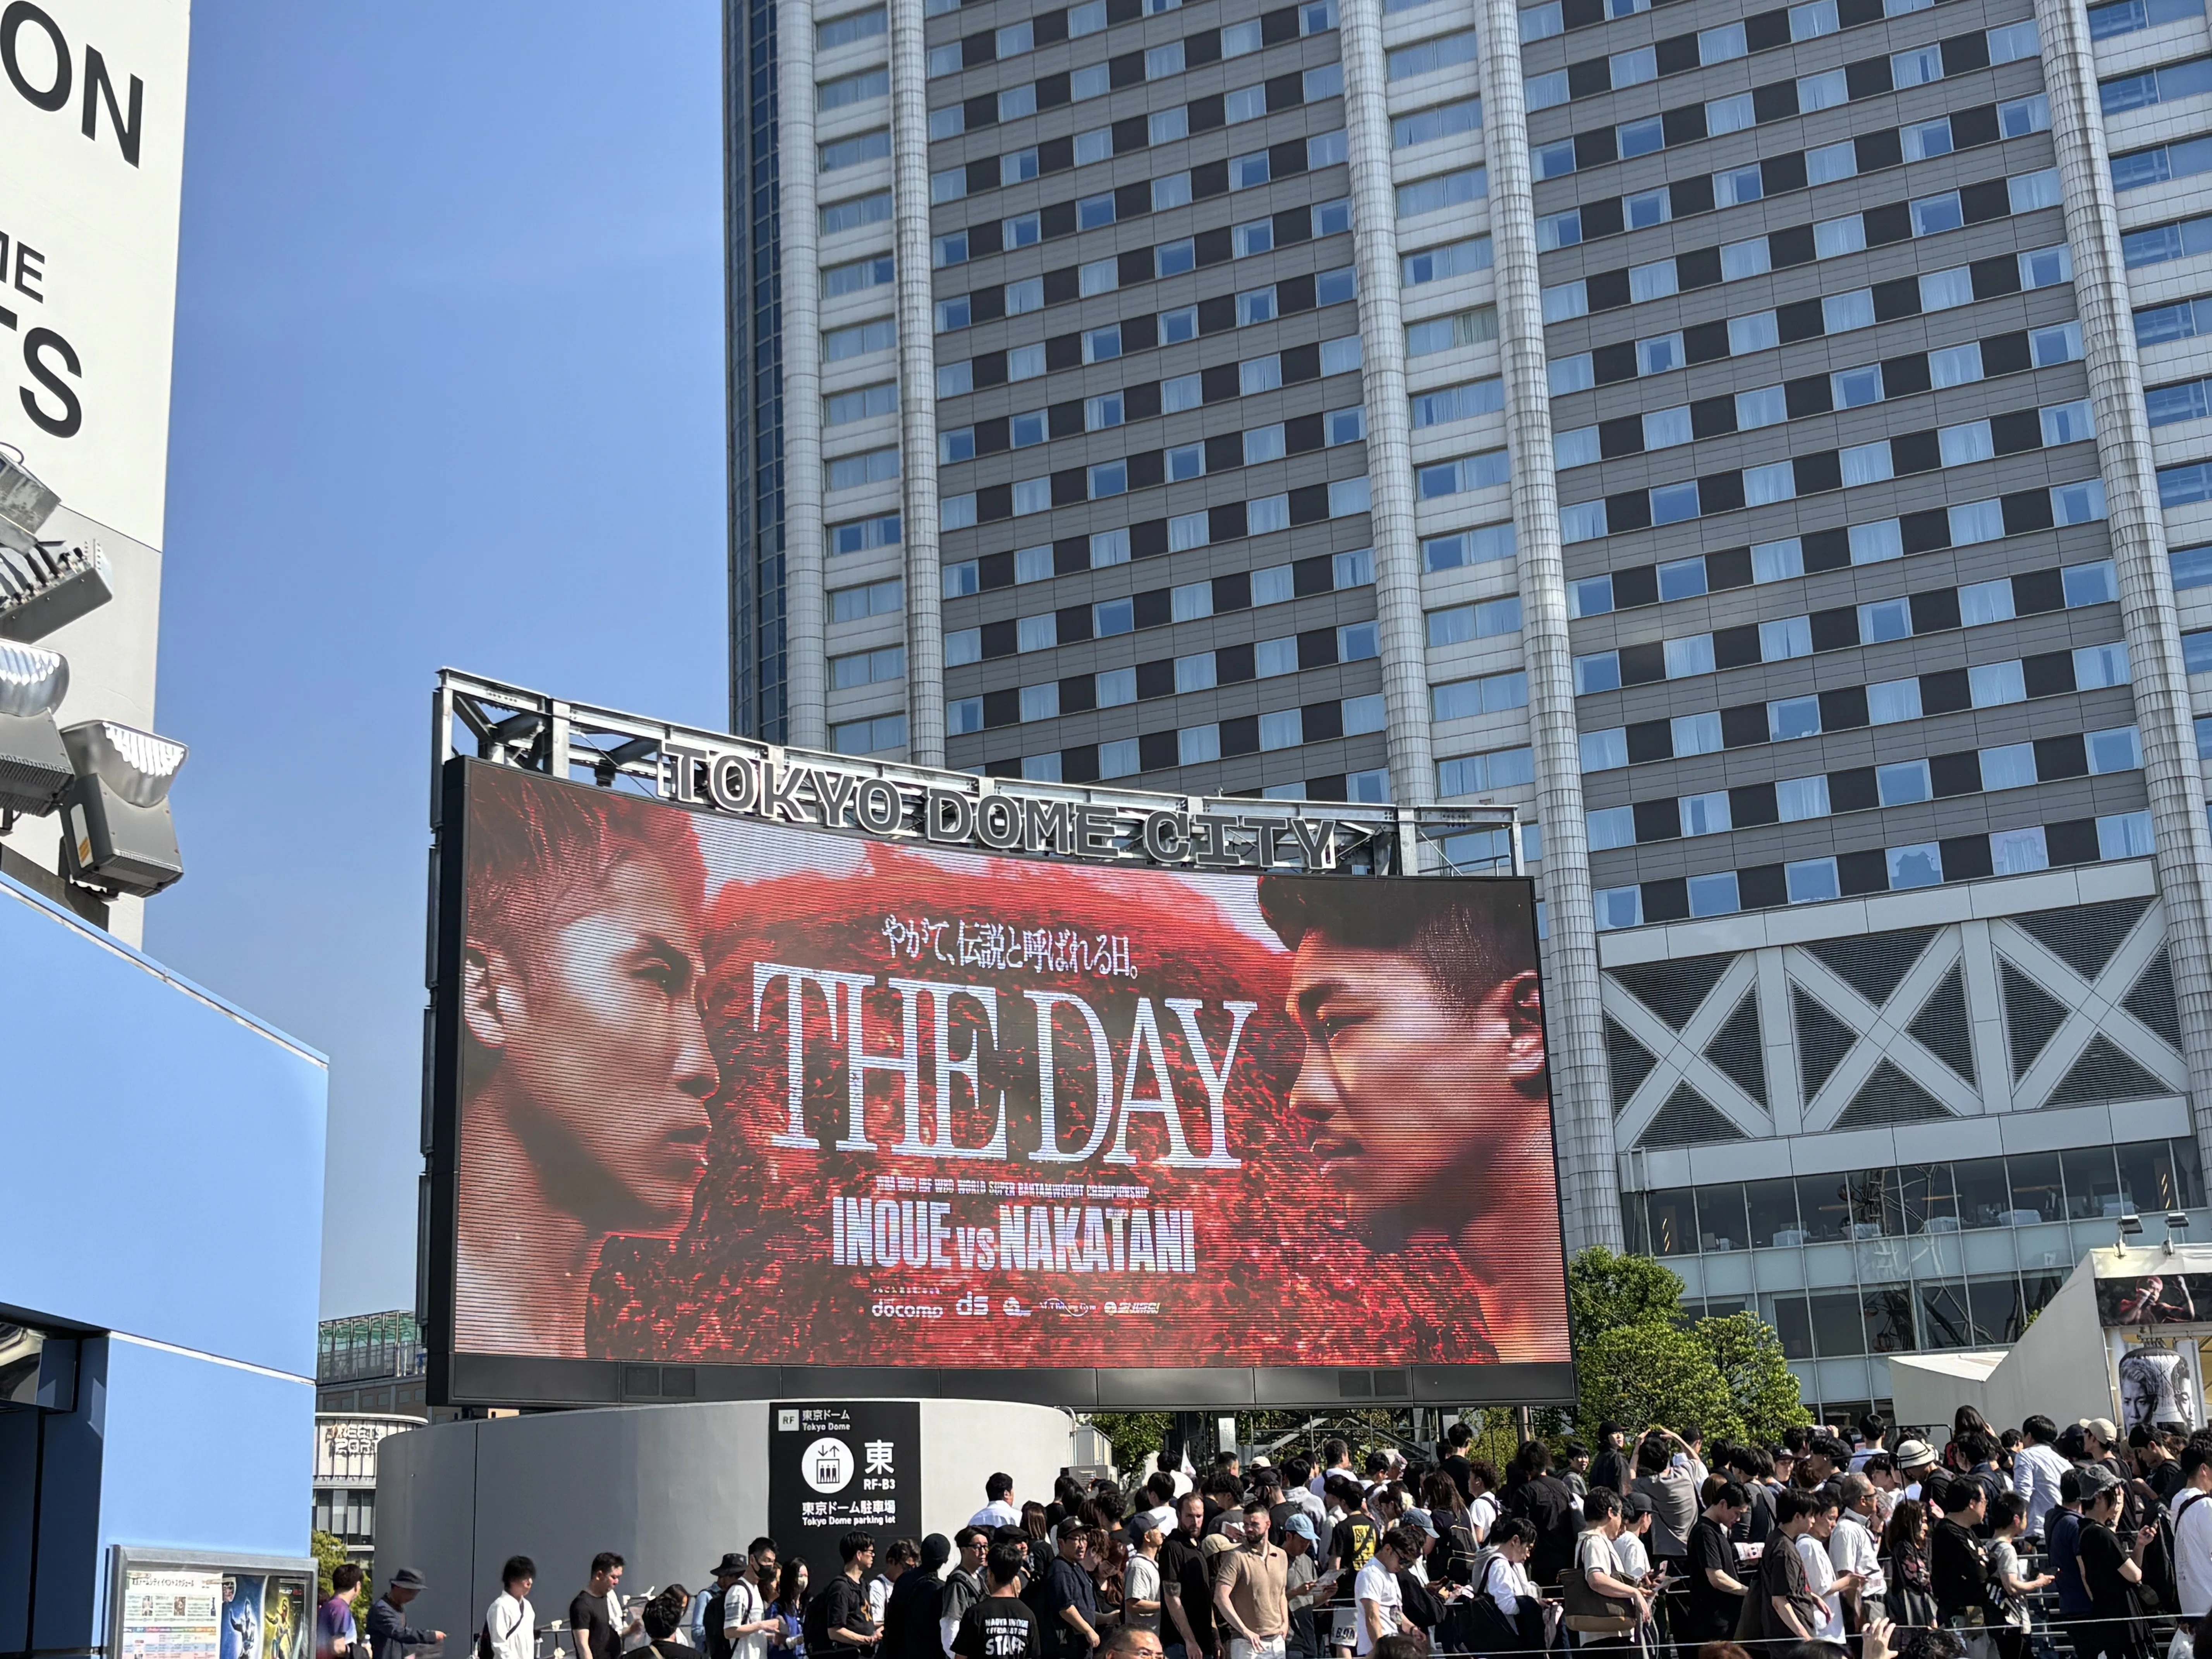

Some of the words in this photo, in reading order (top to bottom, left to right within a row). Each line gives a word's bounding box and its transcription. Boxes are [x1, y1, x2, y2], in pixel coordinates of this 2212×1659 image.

[662, 742, 903, 834] TOKYO
[926, 787, 1121, 859] DOME
[1144, 809, 1338, 870] CITY
[881, 914, 1138, 979] やがて、伝説と呼ばれる日。
[753, 961, 1007, 1160] THE
[1024, 990, 1258, 1169] DAY
[989, 1181, 1015, 1196] SUPER
[1087, 1185, 1150, 1199] CHAMPIONSHIP
[832, 1196, 953, 1268] INOUE
[1000, 1204, 1196, 1273] NAKATANI
[872, 1299, 943, 1318] docomo
[782, 1416, 795, 1425] RF
[802, 1410, 850, 1421] 東京ドーム
[802, 1422, 826, 1432] Tokyo
[828, 1422, 850, 1431] Dome
[864, 1439, 895, 1475] 東
[863, 1479, 896, 1491] RF-B3
[802, 1500, 896, 1516] 東京ドーム駐車場
[802, 1517, 827, 1527] Tokyo
[829, 1516, 852, 1525] Dome
[853, 1515, 884, 1526] parking
[885, 1515, 896, 1524] lot
[985, 1635, 1025, 1656] STAFF
